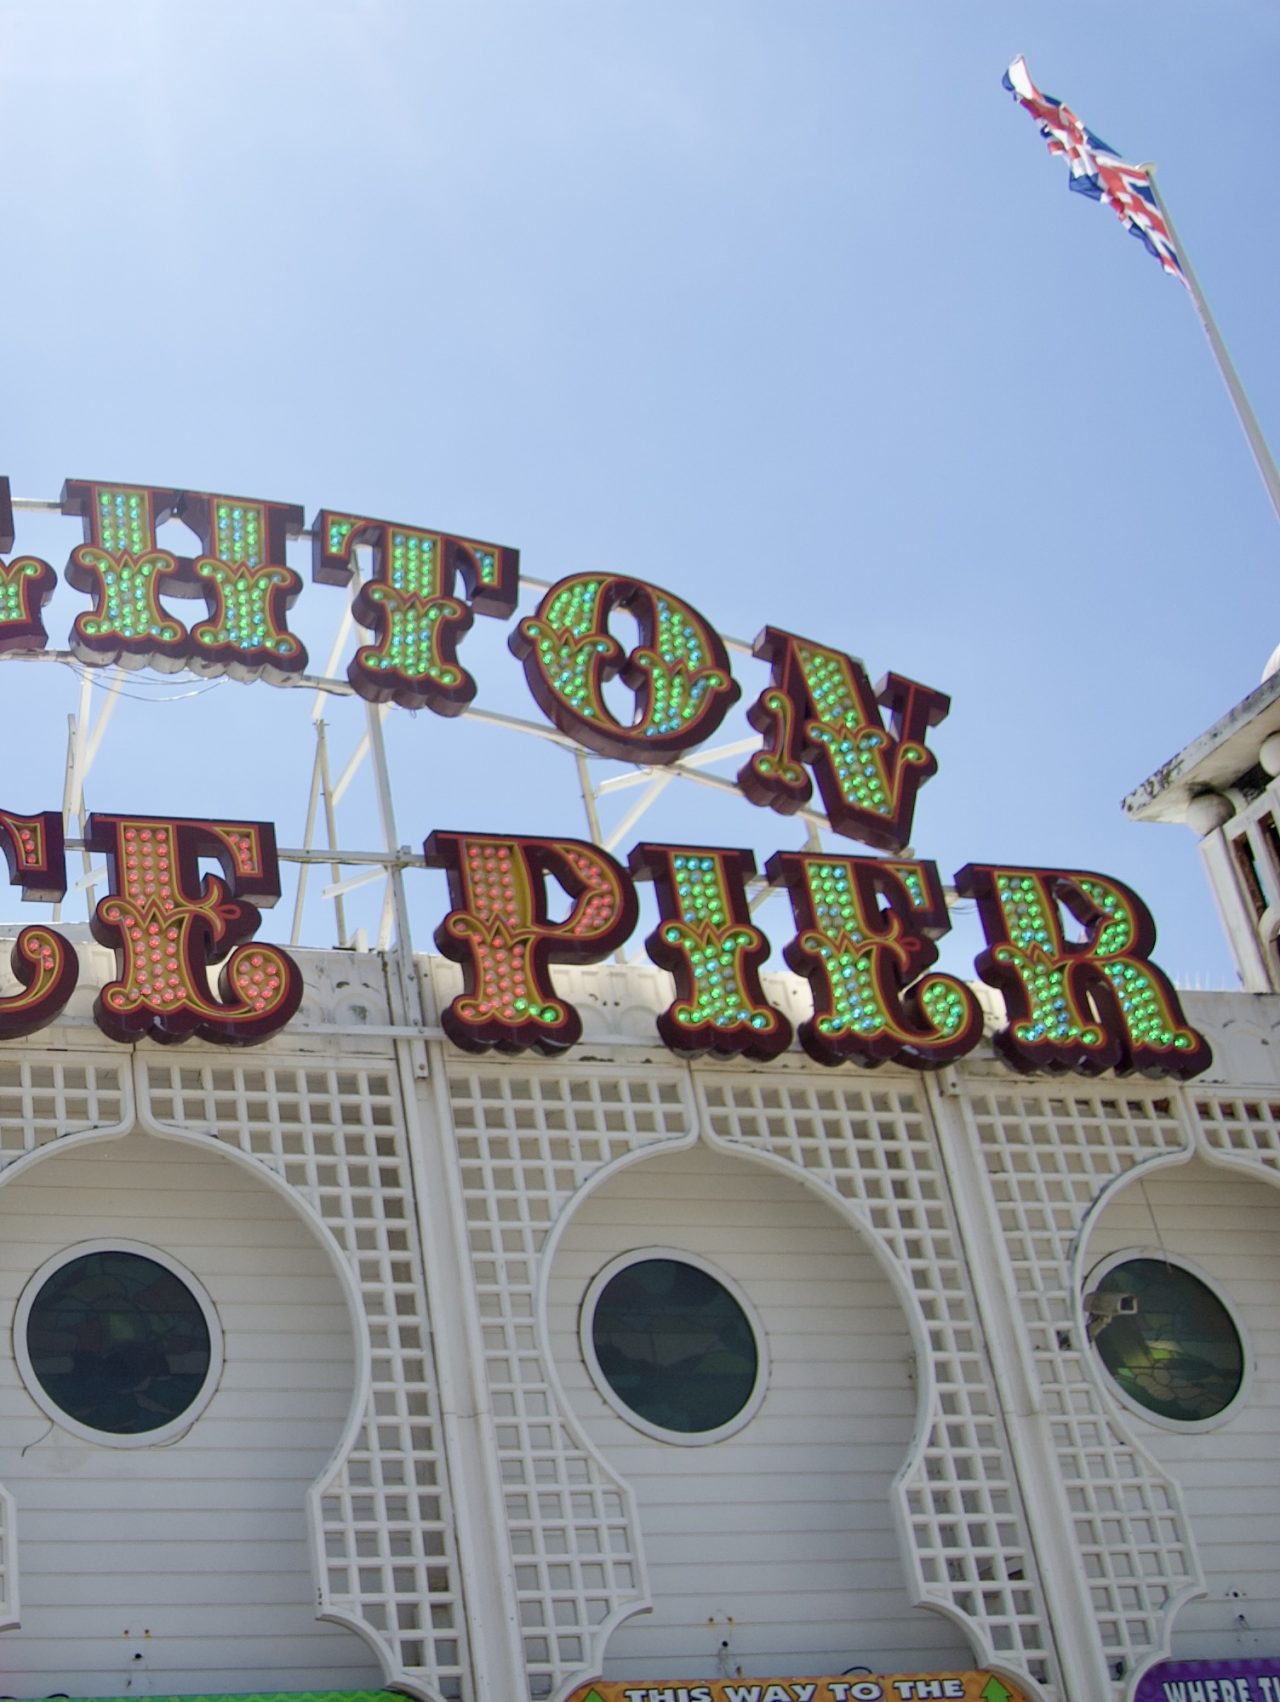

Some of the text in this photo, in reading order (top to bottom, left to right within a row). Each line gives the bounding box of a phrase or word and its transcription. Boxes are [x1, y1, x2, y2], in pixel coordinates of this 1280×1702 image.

[423, 829, 1214, 1081] PIER
[624, 1678, 965, 1702] THIS WAY TO THE
[1162, 1677, 1250, 1702] WHERE
